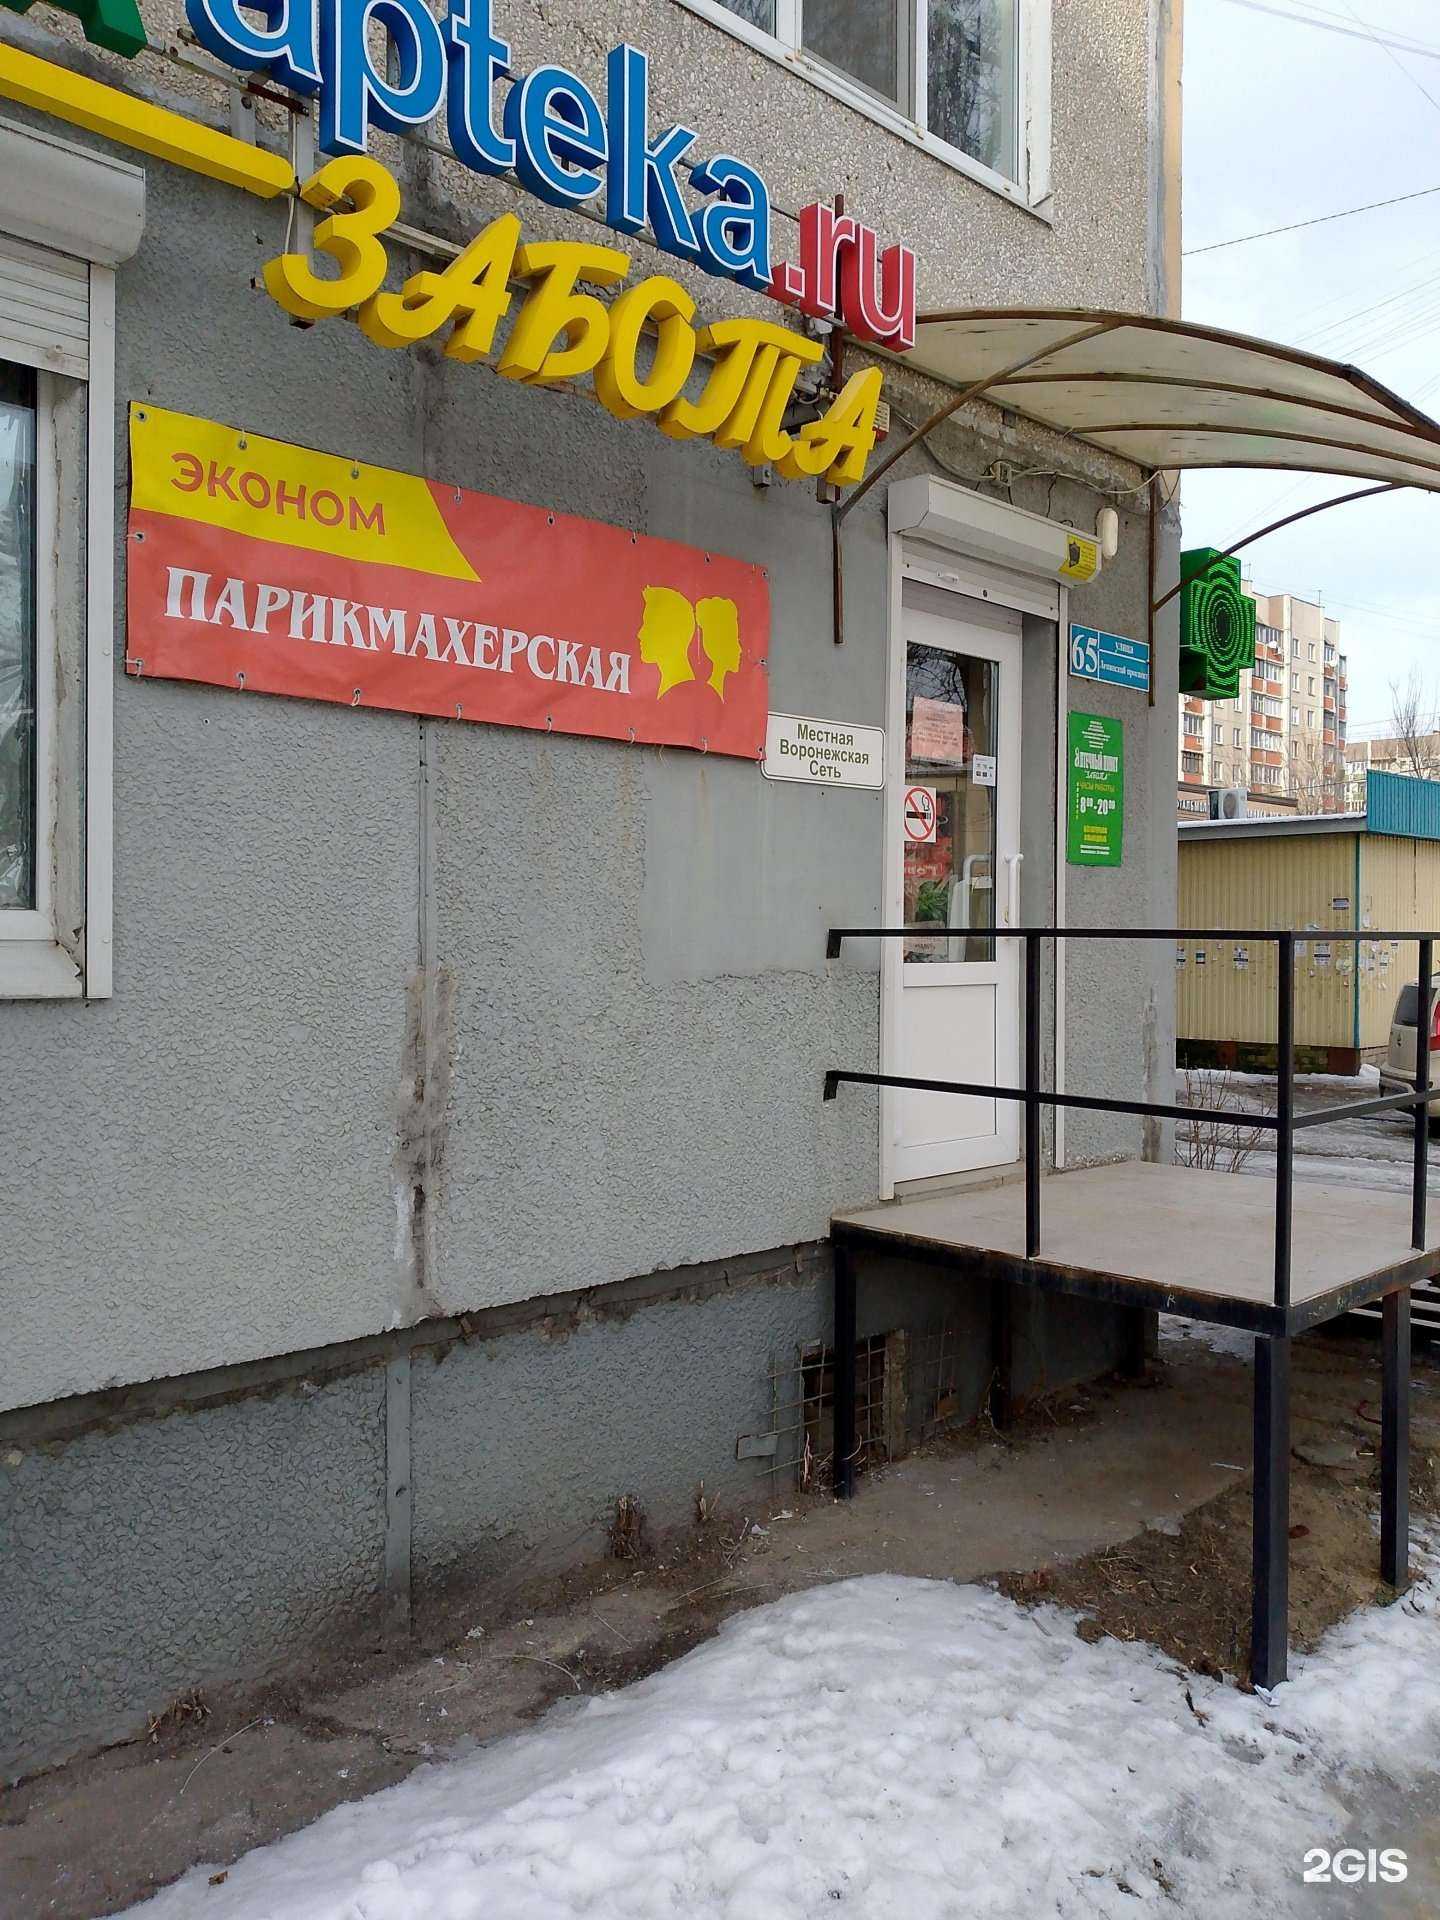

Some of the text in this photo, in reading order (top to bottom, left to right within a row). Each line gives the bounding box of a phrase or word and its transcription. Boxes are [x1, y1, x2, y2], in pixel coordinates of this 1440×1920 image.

[263, 155, 883, 486] ЗАБОТА
[170, 452, 386, 536] ЭКОНОМ
[164, 565, 632, 695] ПАРИКМАХЕРСКАЯ
[1072, 634, 1098, 673] 65
[779, 738, 869, 765] Воронежская
[797, 723, 854, 746] Местная
[809, 760, 842, 778] Сеть
